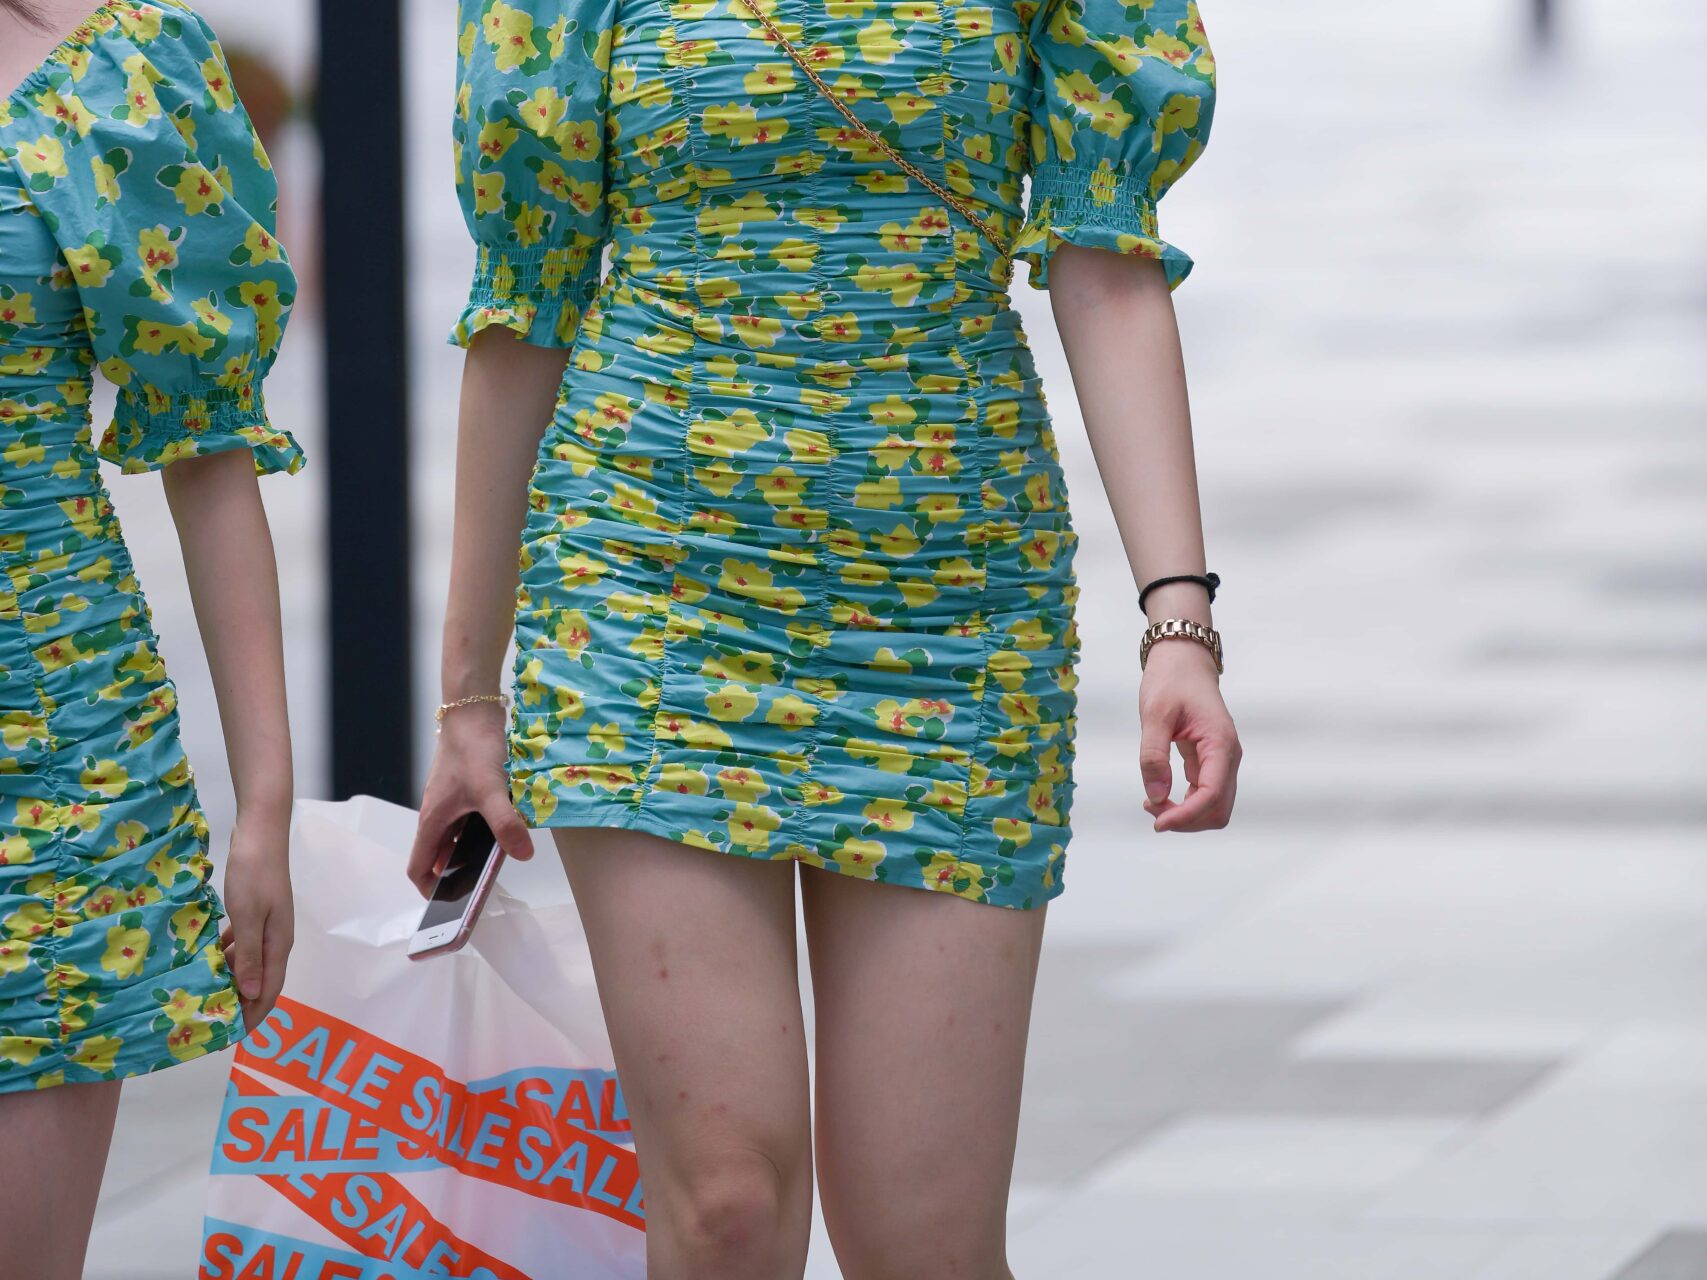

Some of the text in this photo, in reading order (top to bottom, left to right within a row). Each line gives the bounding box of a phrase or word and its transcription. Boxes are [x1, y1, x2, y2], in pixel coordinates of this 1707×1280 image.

[222, 1106, 380, 1164] SALE
[240, 1006, 405, 1111] SALE
[401, 1075, 512, 1169] SALE
[330, 1174, 461, 1275] SALE
